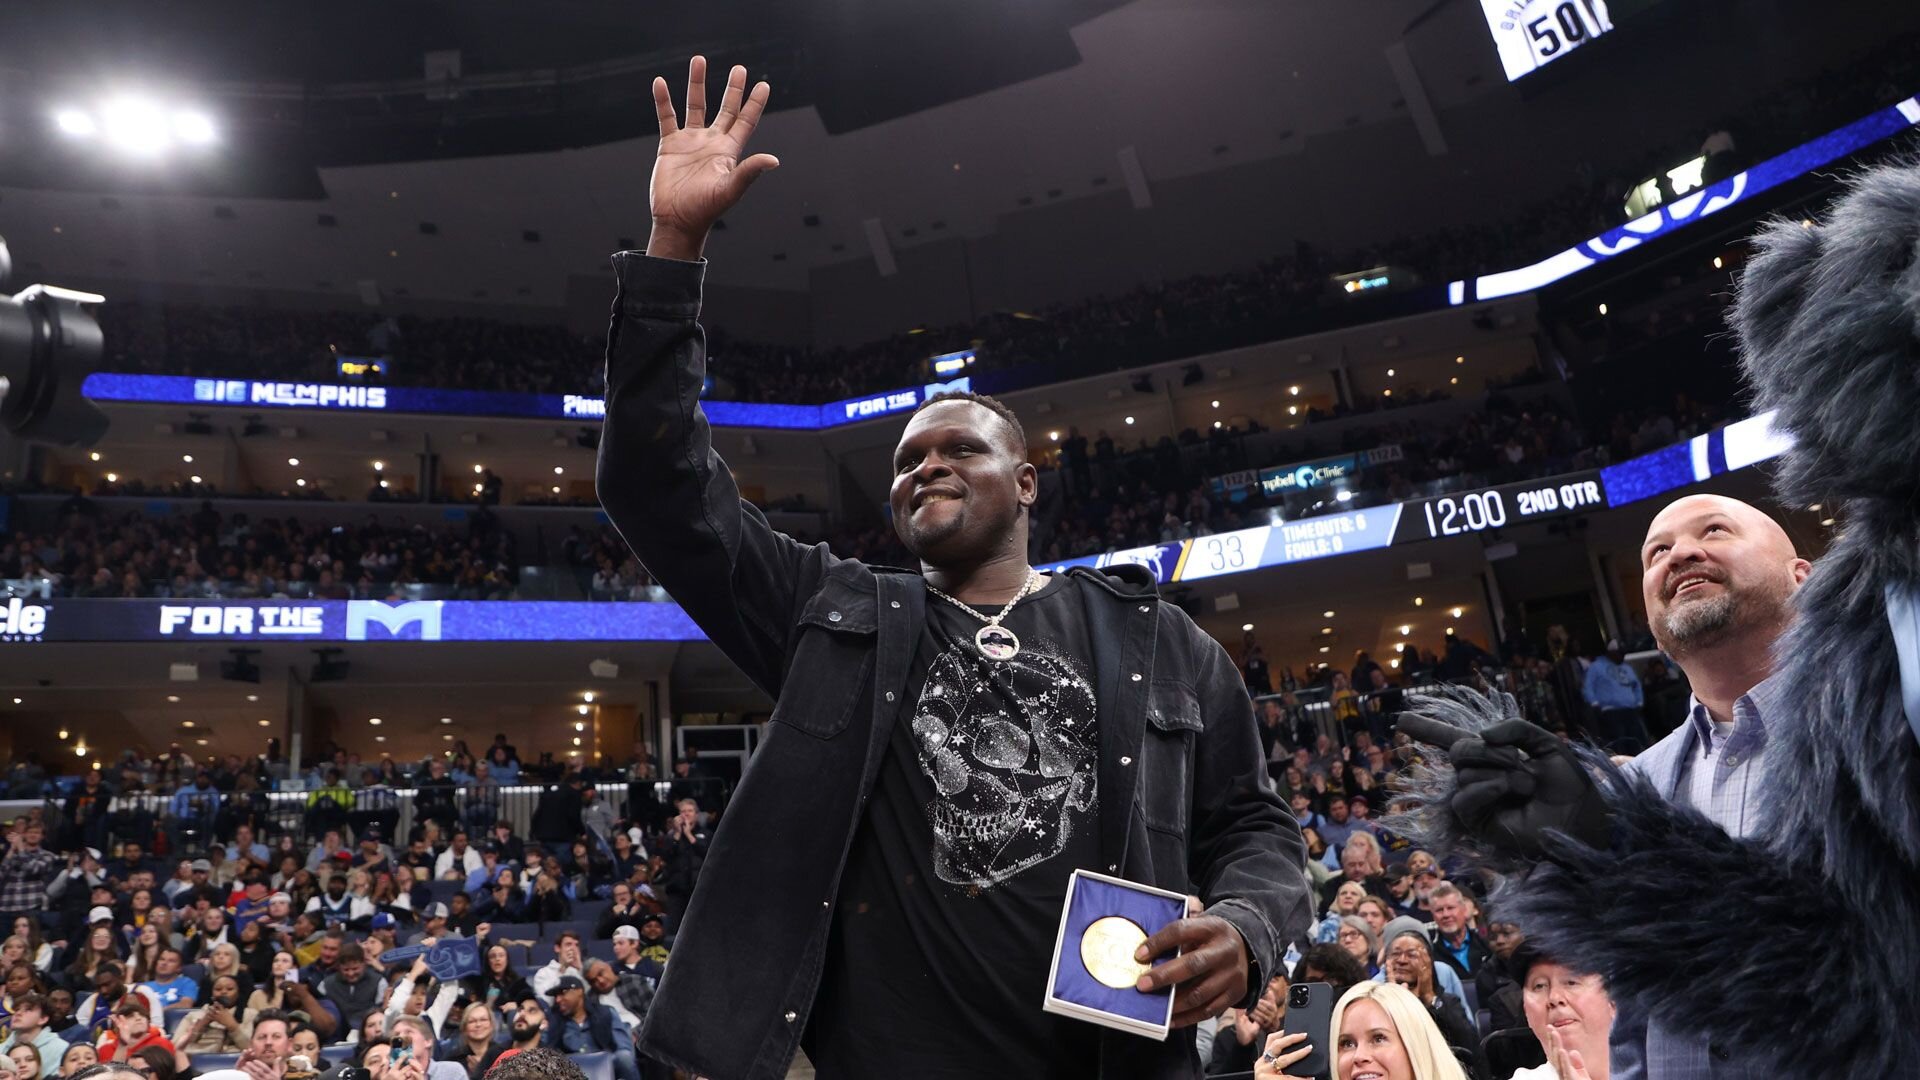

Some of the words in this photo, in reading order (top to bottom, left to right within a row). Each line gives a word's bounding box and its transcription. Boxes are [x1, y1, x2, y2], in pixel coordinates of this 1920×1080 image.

[1500, 0, 1534, 30] GRI
[1527, 2, 1585, 56] 50
[252, 382, 387, 408] MEMPHIS
[846, 398, 887, 418] FOR
[887, 391, 917, 409] THE
[1315, 465, 1345, 480] Clinic
[1424, 490, 1507, 538] 12:00
[1517, 488, 1559, 516] 2ND
[1560, 480, 1602, 510] QTR
[1282, 517, 1354, 542] TIMEOUTS:
[1207, 535, 1245, 571] 33
[1284, 540, 1332, 560] FOULS:
[159, 605, 254, 635] FOR
[258, 606, 324, 634] THE
[1033, 776, 1072, 795] CENTAURUS
